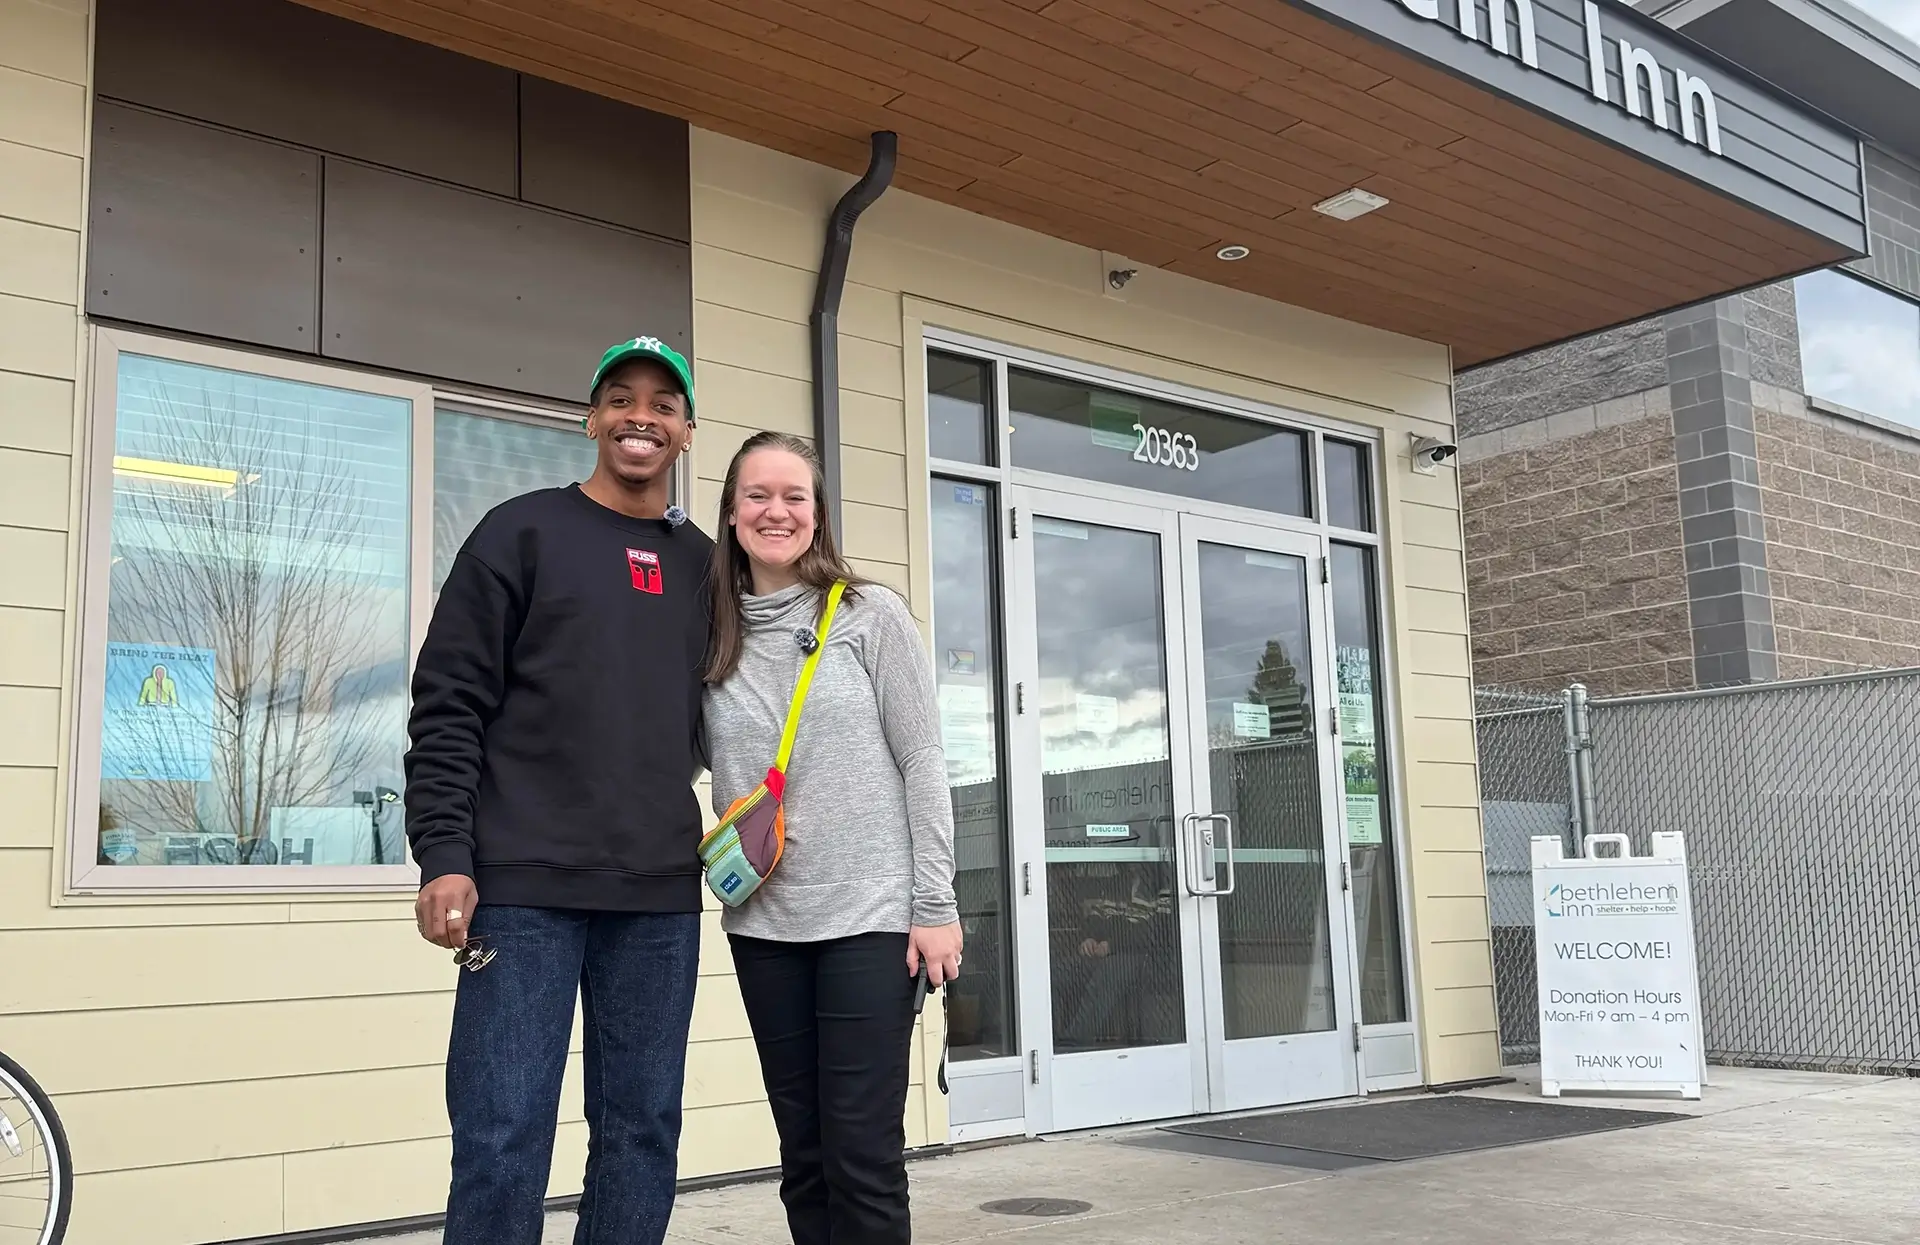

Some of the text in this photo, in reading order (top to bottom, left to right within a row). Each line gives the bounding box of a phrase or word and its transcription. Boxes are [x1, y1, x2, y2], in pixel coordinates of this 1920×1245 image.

[1585, 0, 1722, 156] Inn
[1132, 423, 1199, 471] 20363
[152, 651, 176, 660] THE
[1560, 882, 1678, 901] bethlehem
[1561, 901, 1677, 917] inn shelter help hope
[1554, 941, 1671, 960] WELCOME!
[1550, 989, 1682, 1004] Donation Hours
[1544, 1010, 1594, 1022] Mon-Fri
[1597, 1010, 1606, 1022] 9
[1610, 1012, 1635, 1022] am
[1651, 1010, 1660, 1021] 4
[1664, 1012, 1690, 1025] pm
[1574, 1055, 1662, 1069] THANK YOU!
